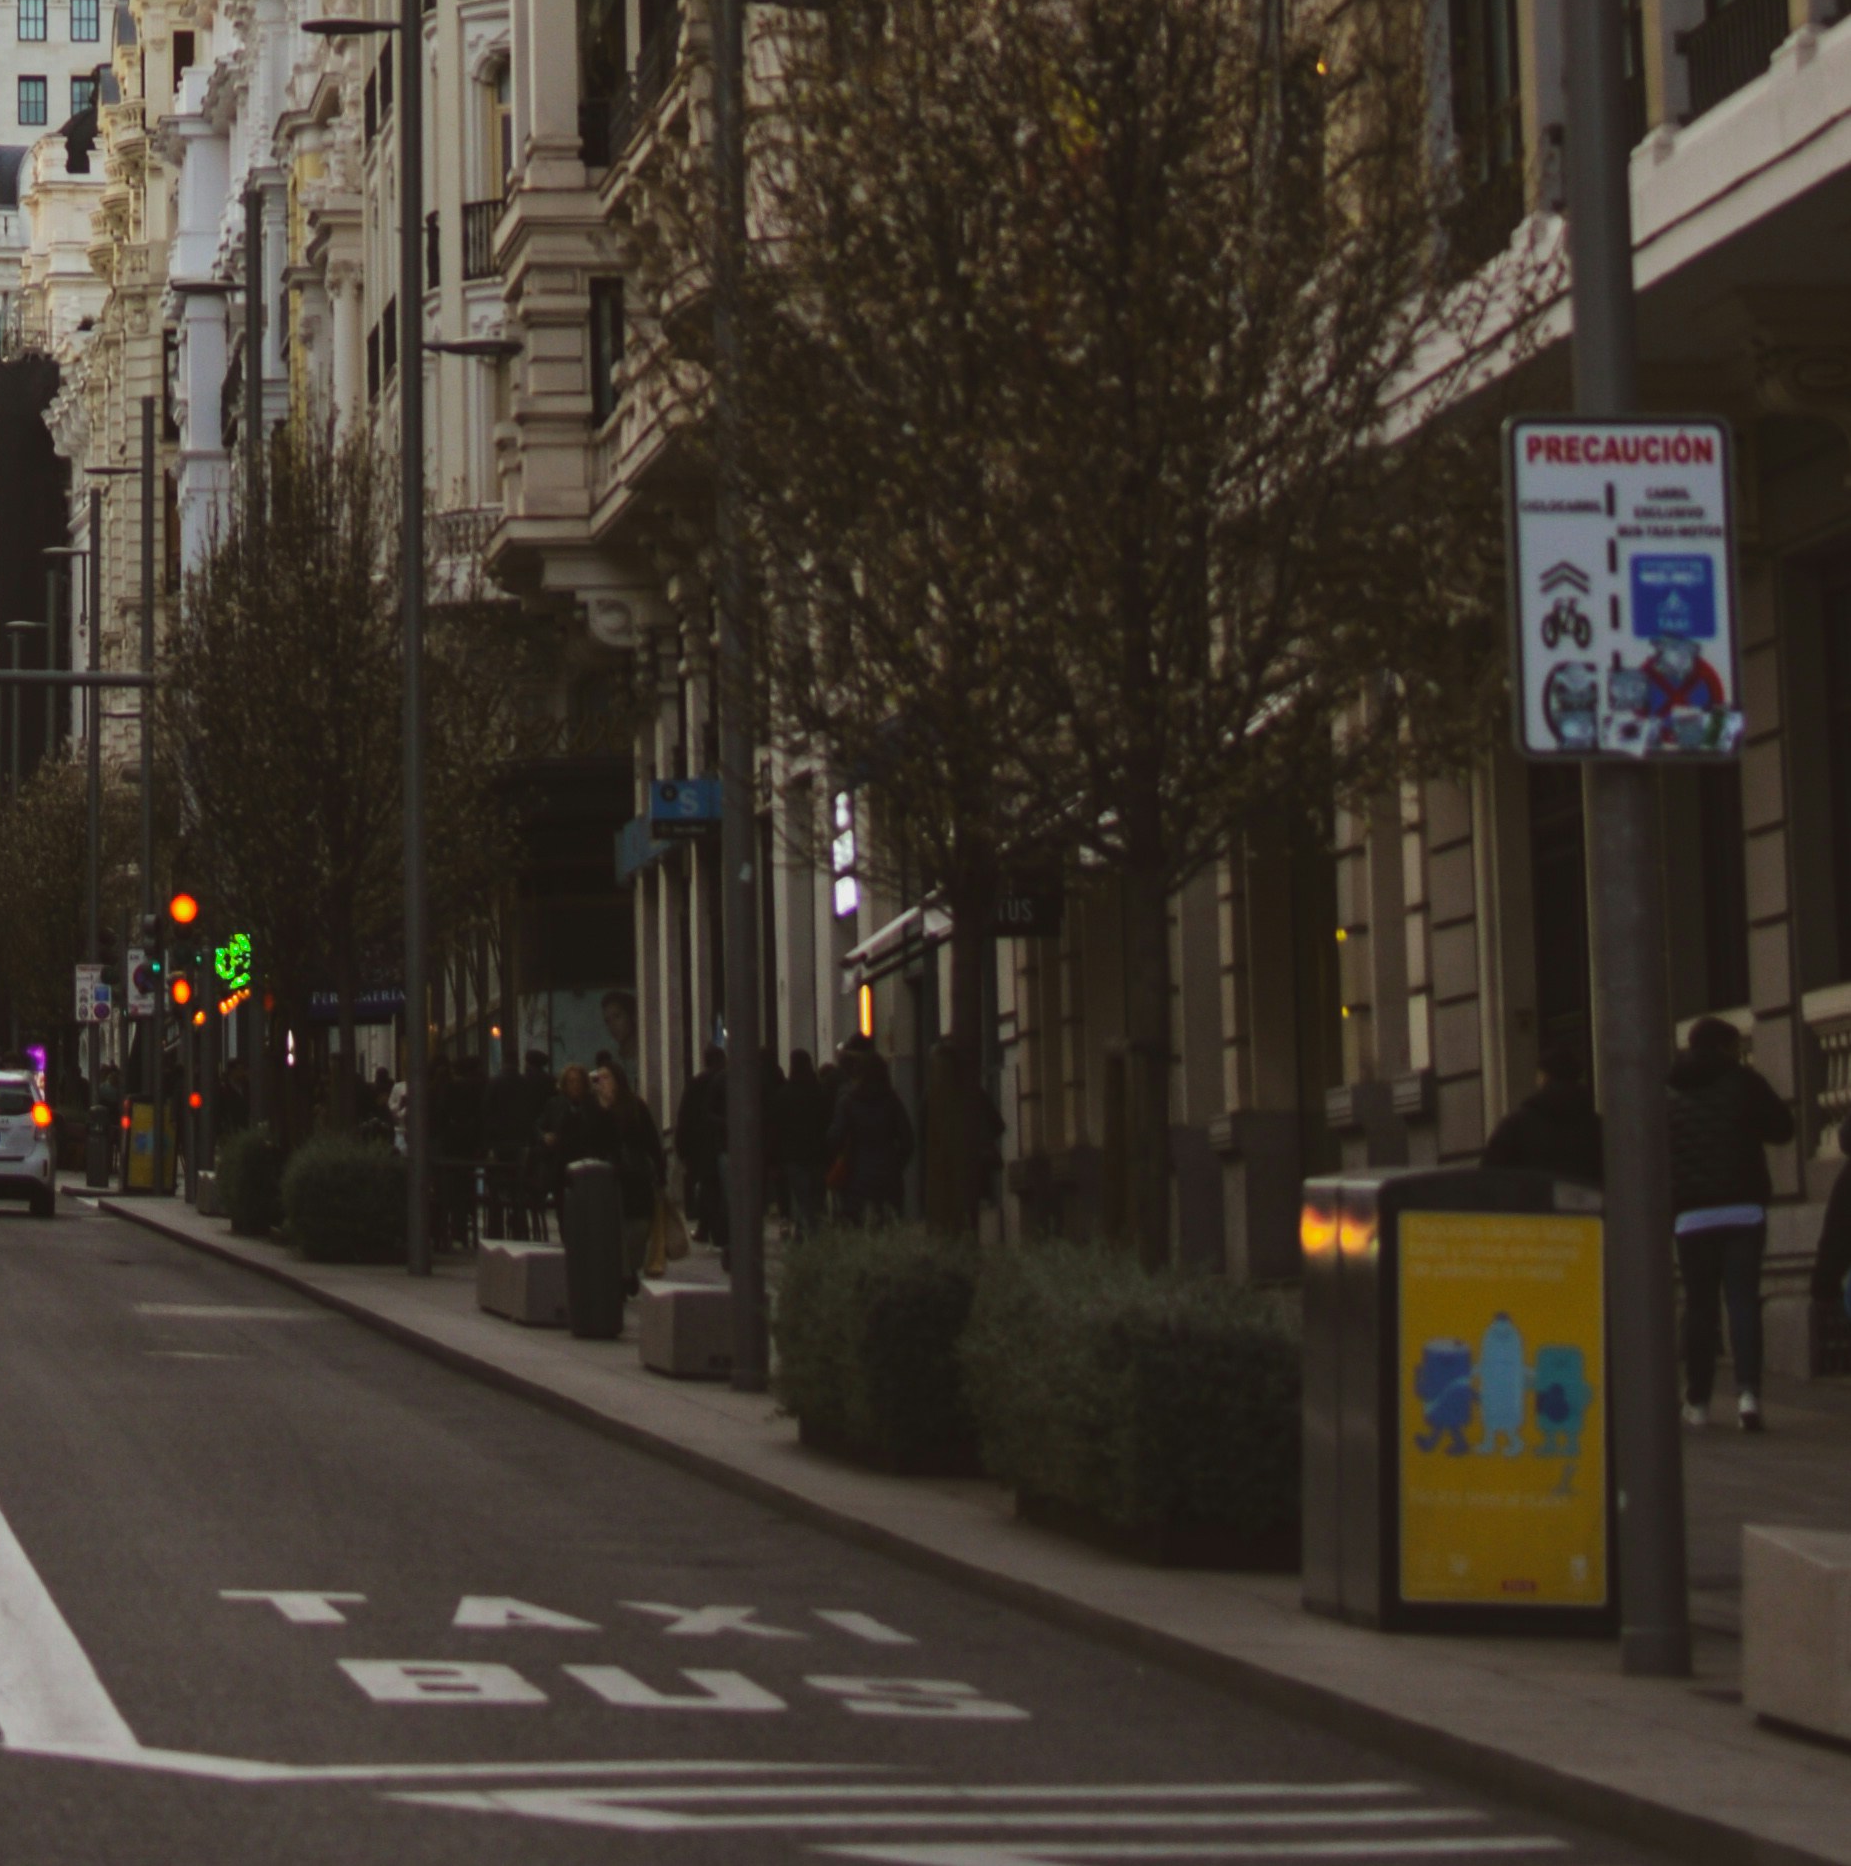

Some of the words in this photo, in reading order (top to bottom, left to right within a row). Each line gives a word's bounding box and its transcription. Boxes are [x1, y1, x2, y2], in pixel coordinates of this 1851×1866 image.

[1526, 430, 1714, 464] PRECAUCIÓN
[218, 1589, 920, 1645] TAXI
[336, 1658, 1033, 1720] BUS
